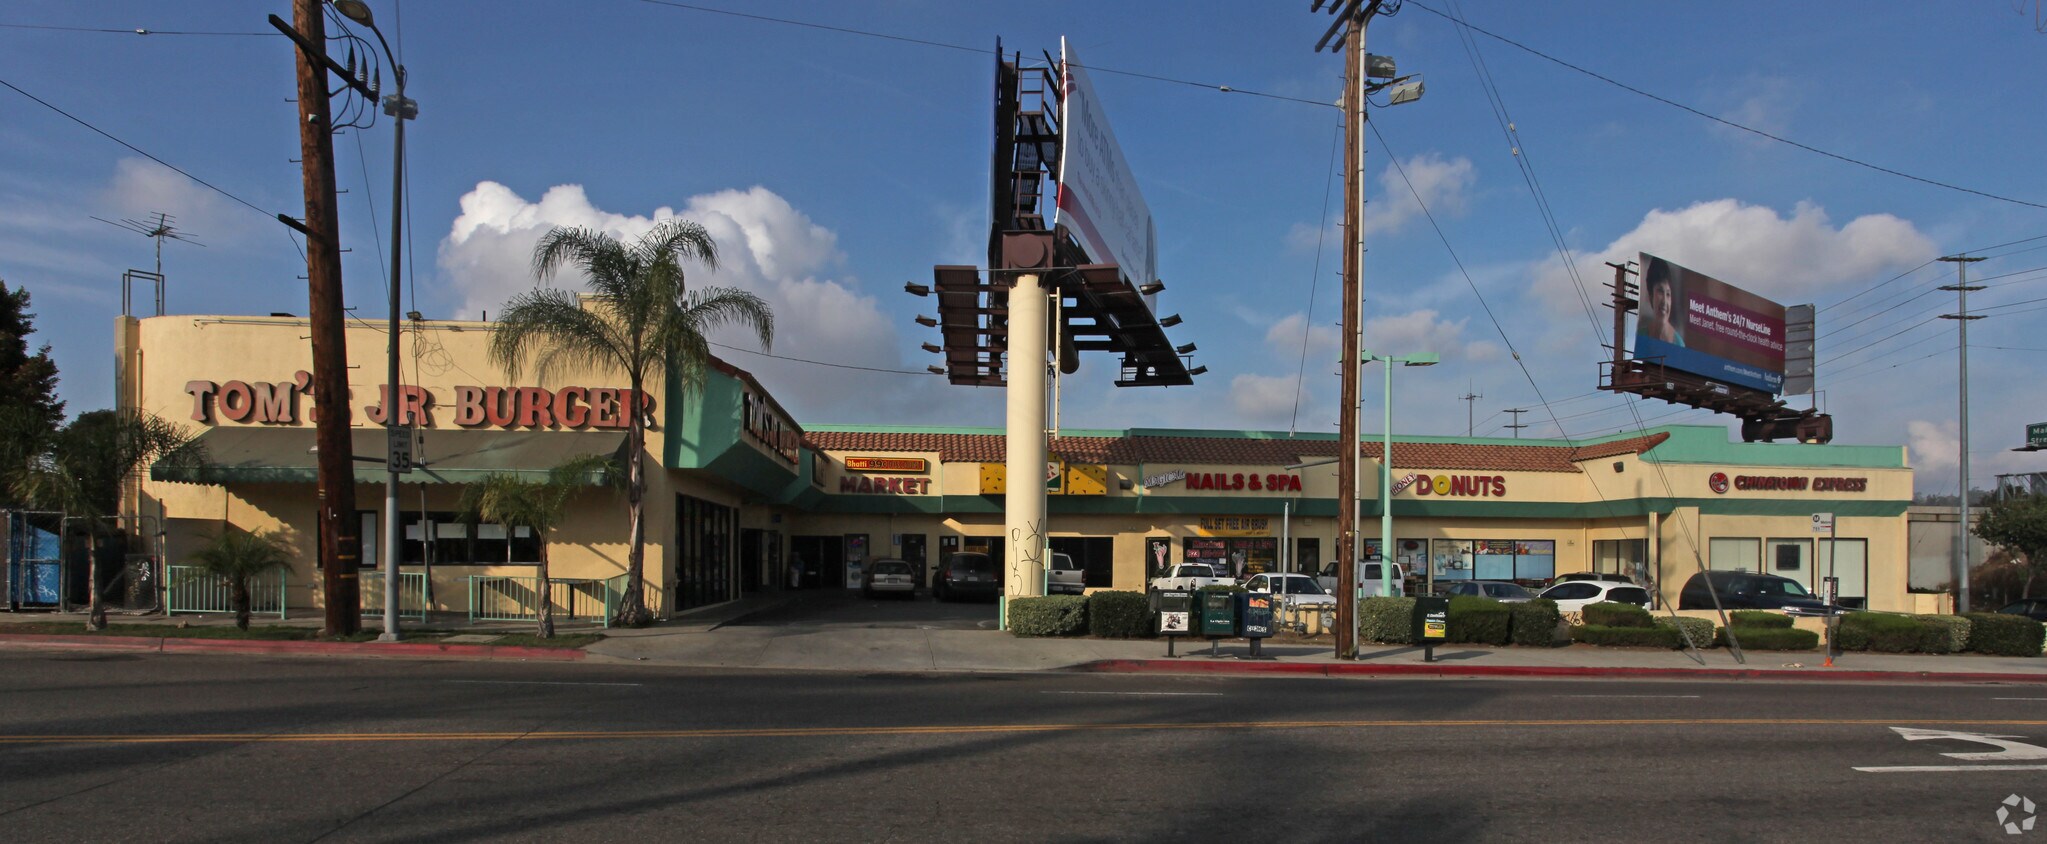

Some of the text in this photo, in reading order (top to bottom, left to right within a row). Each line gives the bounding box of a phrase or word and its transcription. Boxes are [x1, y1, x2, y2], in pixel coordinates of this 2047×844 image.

[1689, 298, 1771, 336] Meet Anthem's 24/7 NurseLine
[1689, 313, 1701, 327] Meet
[1715, 321, 1725, 334] free
[1757, 334, 1770, 348] health
[184, 370, 651, 428] TOM' JR BURGER
[392, 451, 410, 469] 35
[846, 459, 867, 468] Bhatti
[839, 476, 930, 495] MARKET
[1185, 472, 1245, 491] NAILS
[1248, 473, 1263, 491] &
[1266, 474, 1303, 491] SPA
[1392, 473, 1506, 497] HONEY DONUTS
[1734, 475, 1868, 492] CHINATOWN EXPRESS
[1200, 518, 1213, 530] FULL
[1214, 518, 1225, 530] SET
[1226, 518, 1239, 530] FREE
